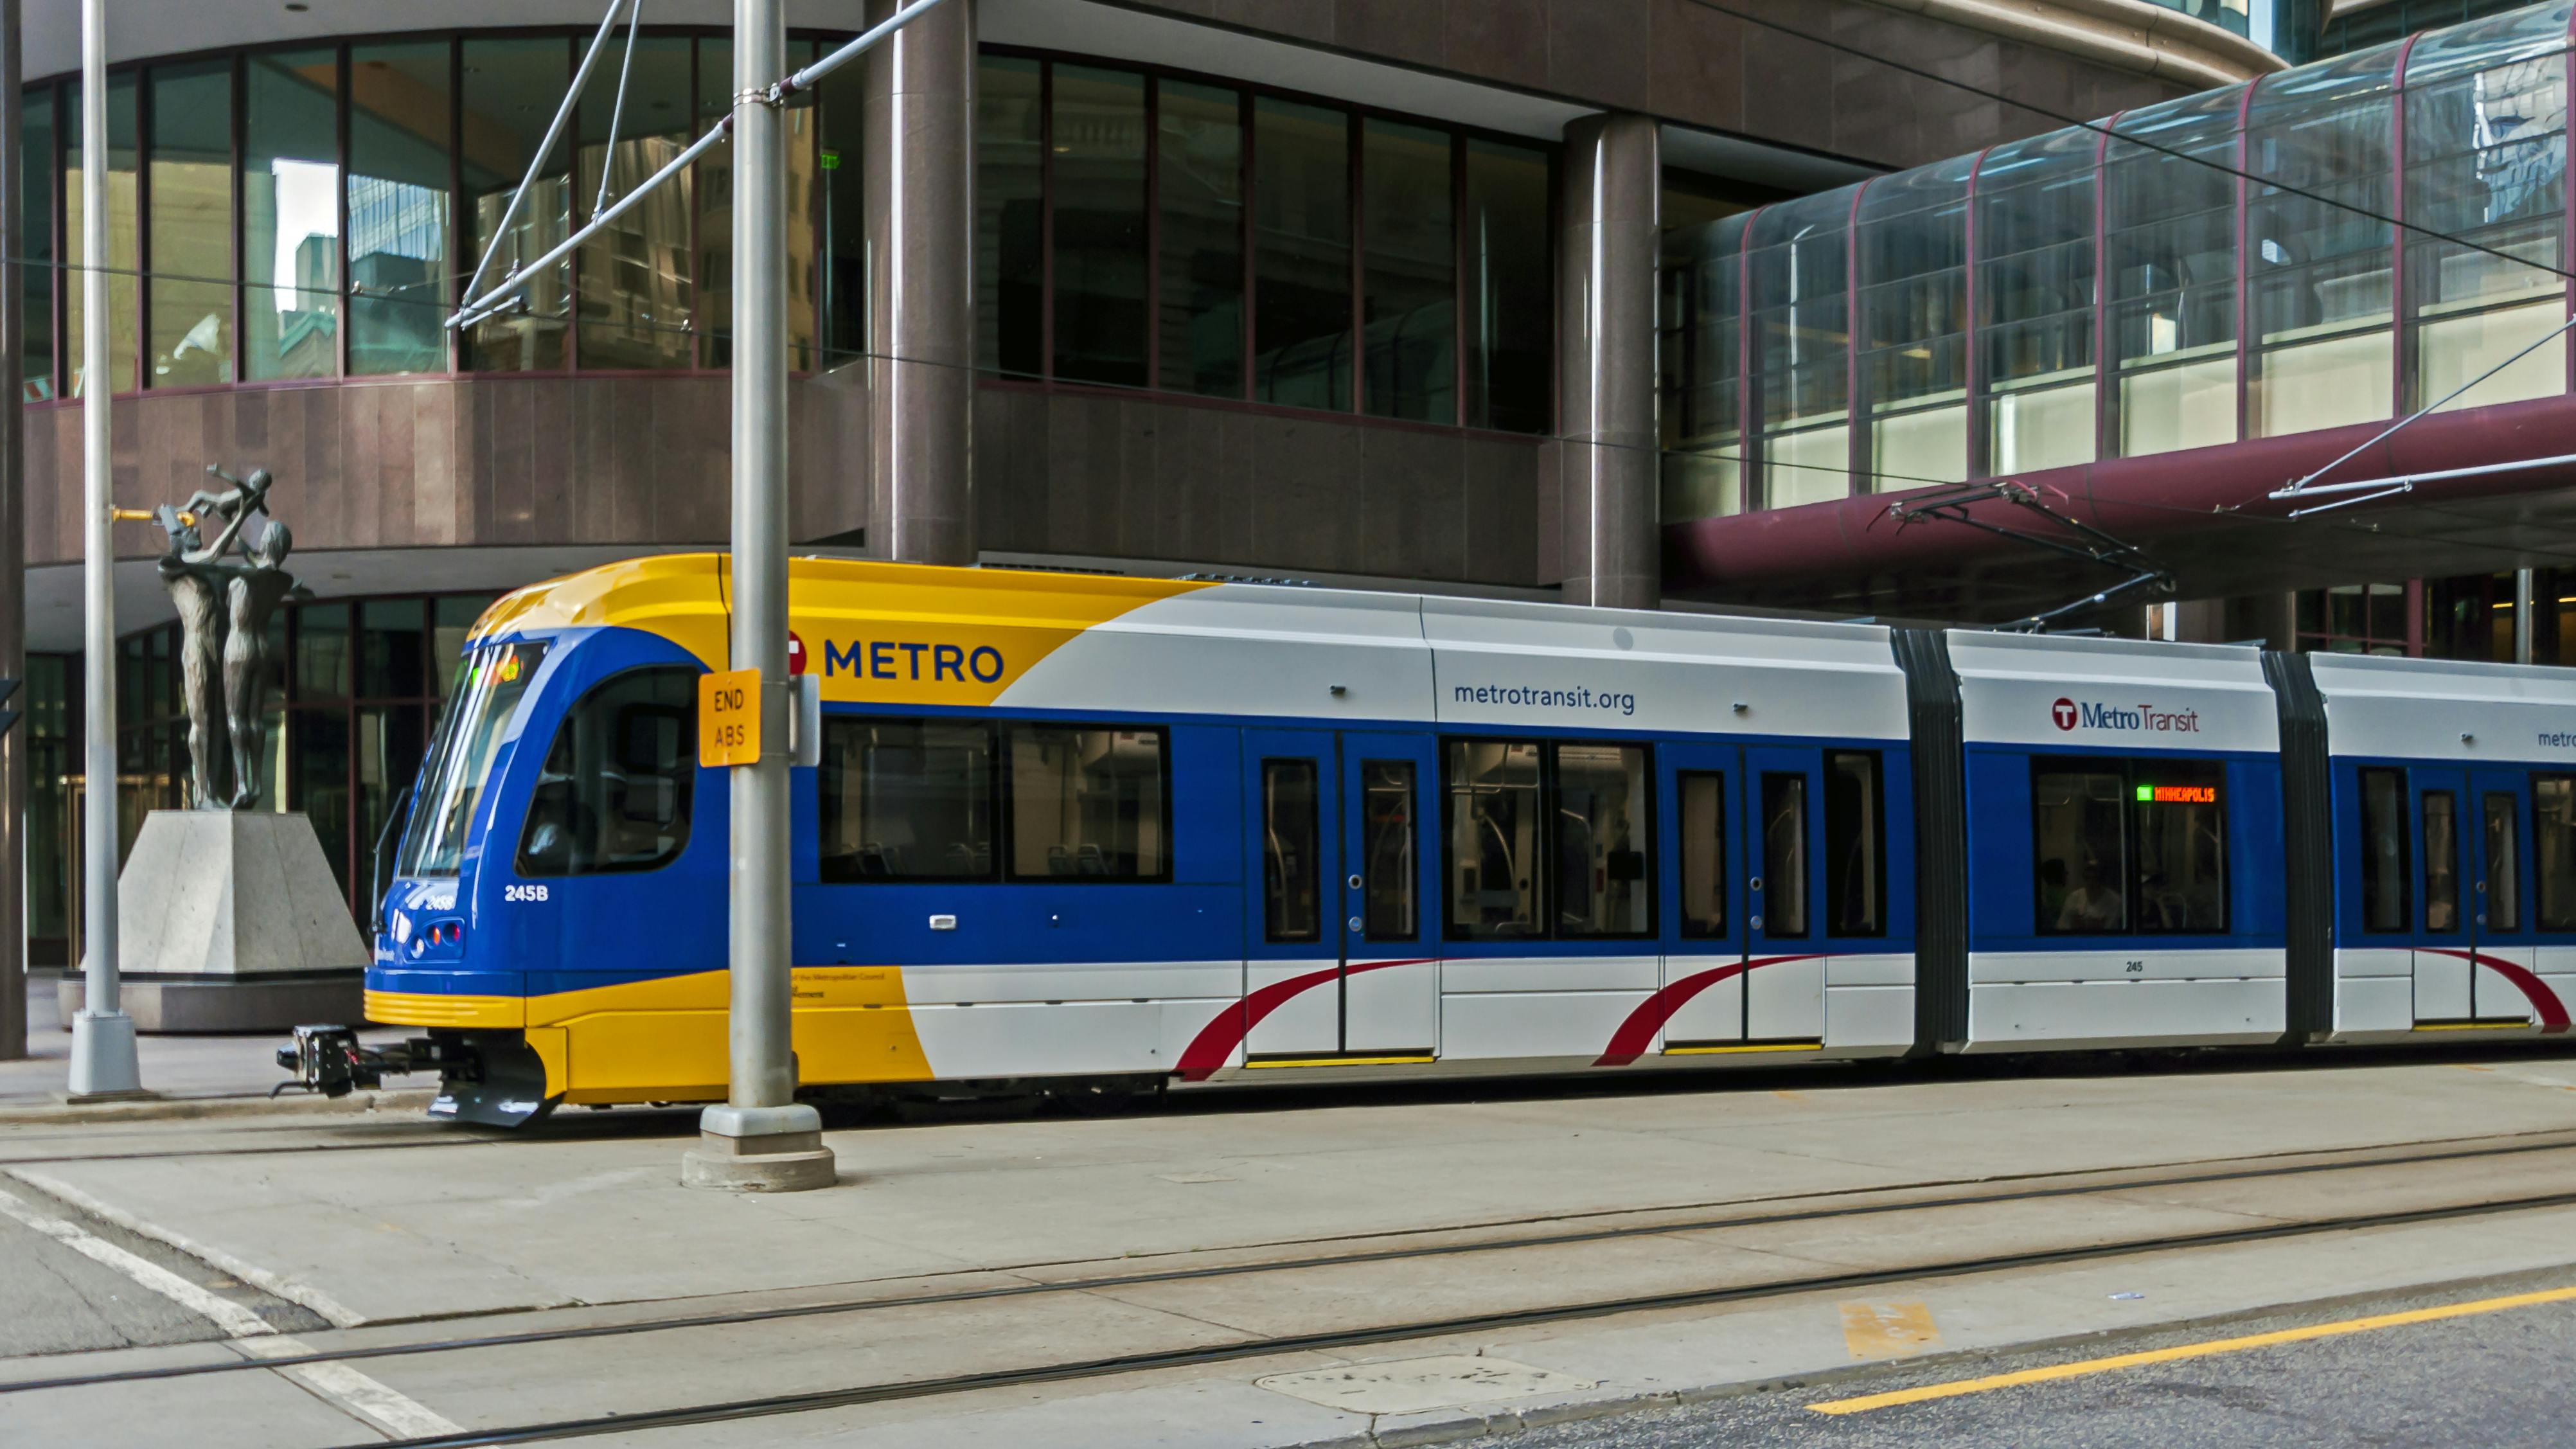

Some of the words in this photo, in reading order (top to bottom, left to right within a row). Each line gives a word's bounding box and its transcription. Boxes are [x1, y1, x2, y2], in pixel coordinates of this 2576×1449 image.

[824, 639, 1004, 684] METRO
[715, 688, 744, 712] END
[1455, 684, 1635, 716] metrotransit.org
[714, 724, 745, 747] ABS
[2154, 787, 2215, 803] MINNEAPOLIS
[505, 885, 548, 902] 245B
[2126, 961, 2143, 972] 245
